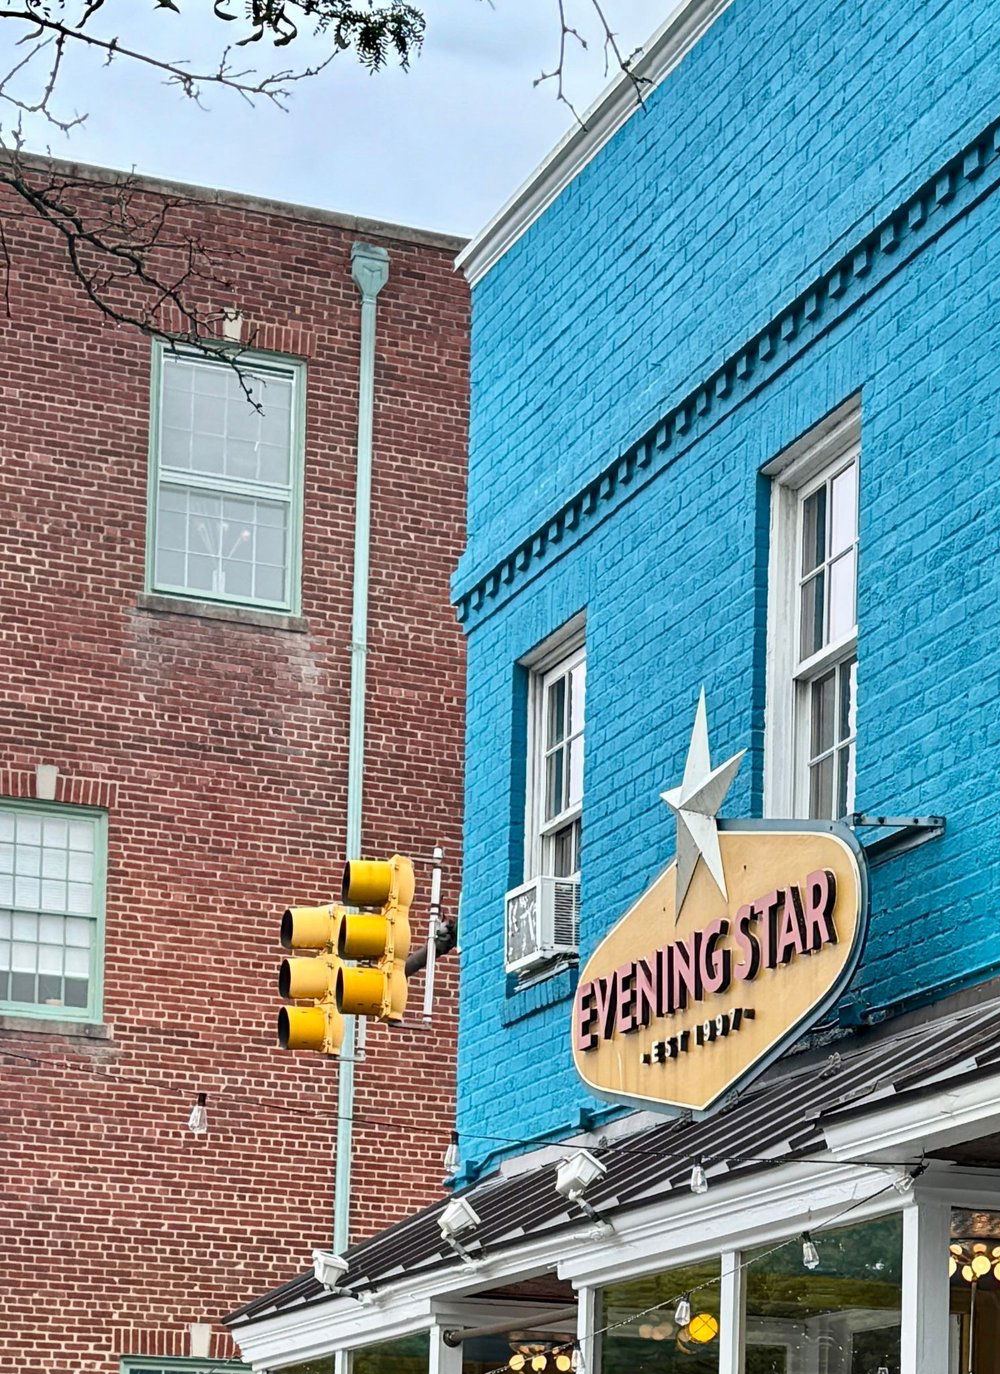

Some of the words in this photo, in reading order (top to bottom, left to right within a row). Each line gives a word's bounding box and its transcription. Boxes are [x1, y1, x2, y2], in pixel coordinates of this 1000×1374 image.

[577, 917, 731, 1052] EVENING
[733, 867, 838, 981] STAR
[651, 1030, 691, 1064] EST
[693, 1007, 743, 1047] 1997
